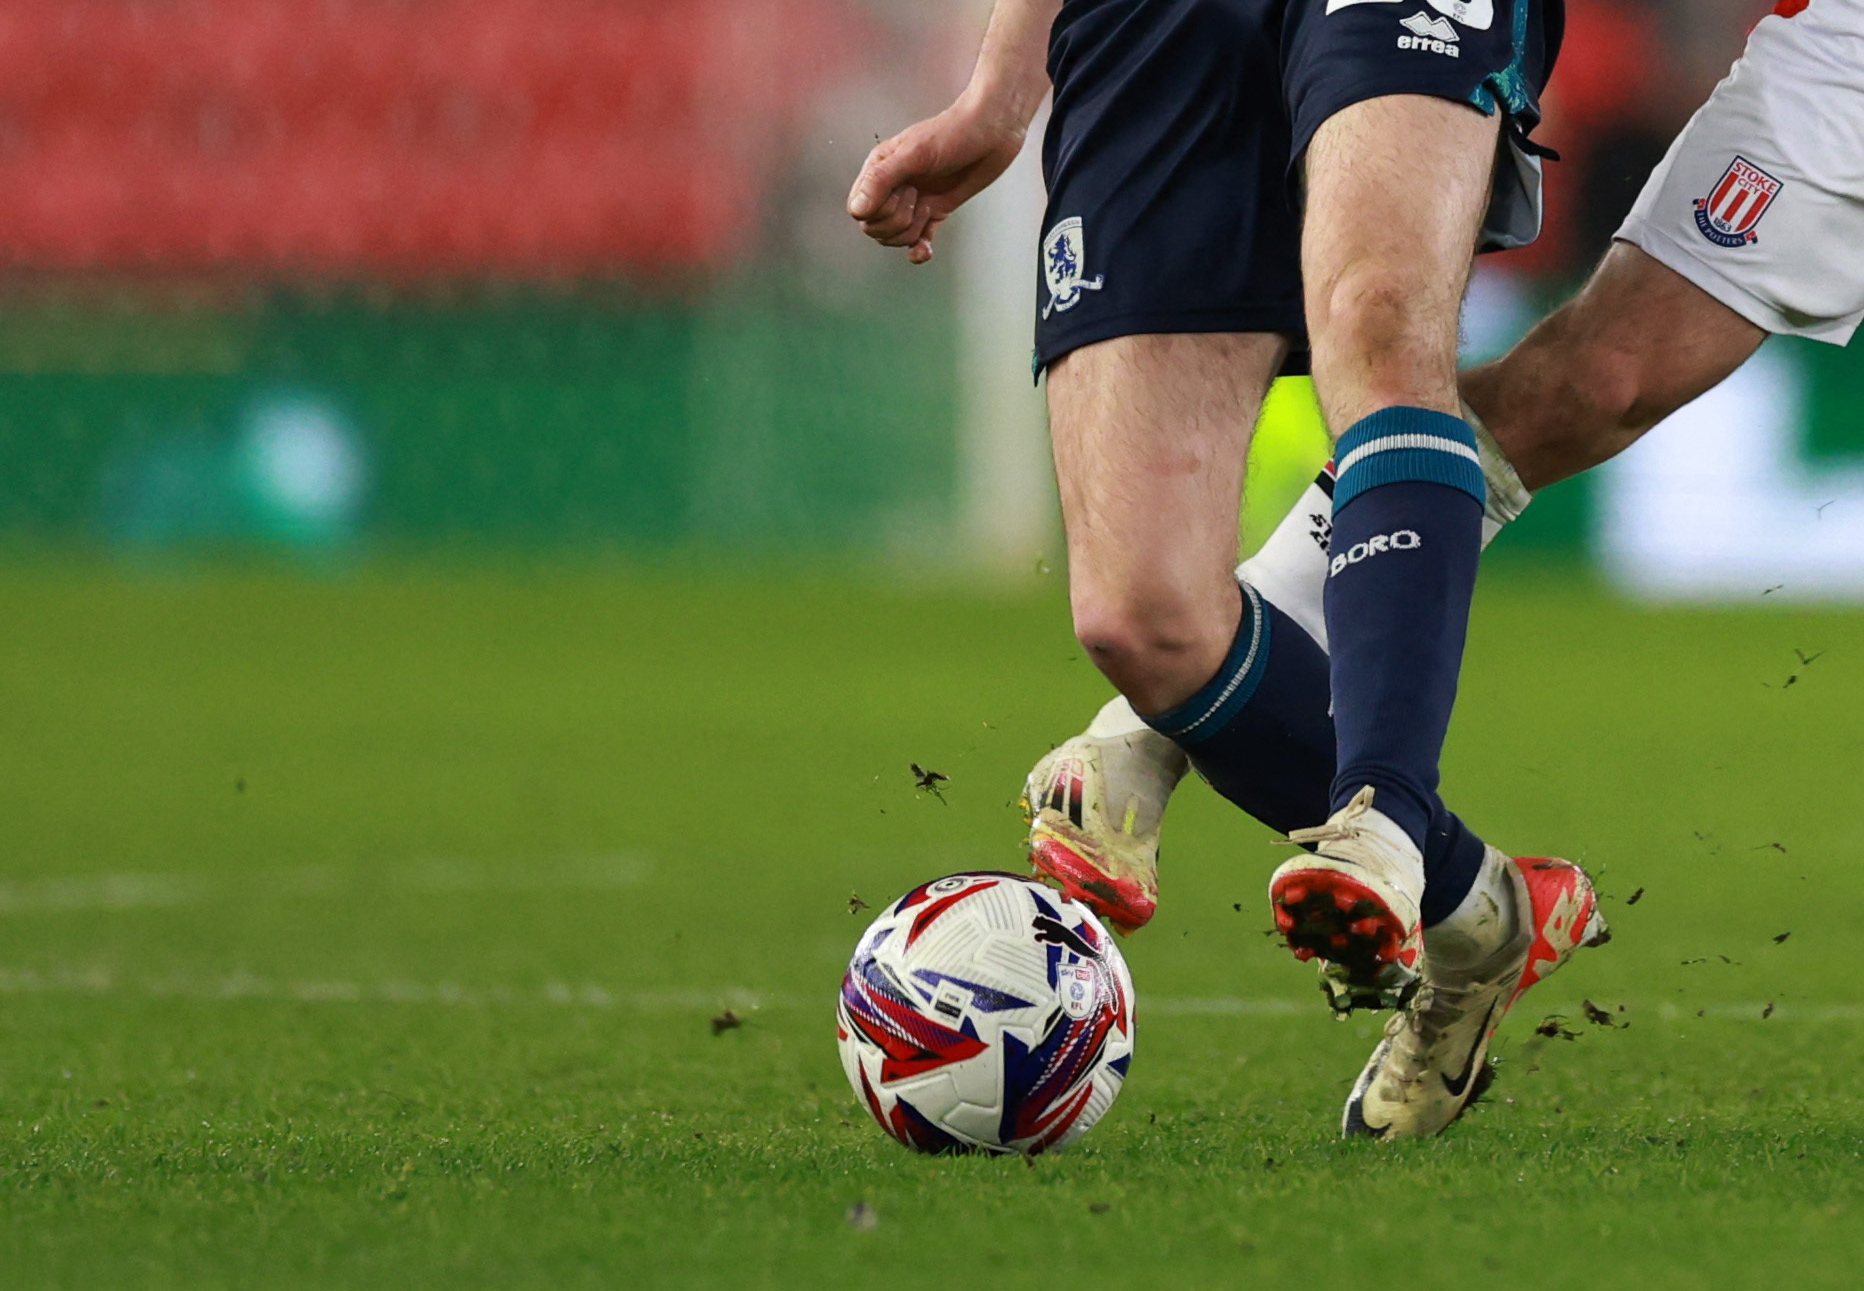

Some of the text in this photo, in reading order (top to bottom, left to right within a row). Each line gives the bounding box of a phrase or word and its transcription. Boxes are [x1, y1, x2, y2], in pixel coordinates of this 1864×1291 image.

[1397, 35, 1460, 58] errea
[1733, 162, 1777, 195] STOKE
[1738, 178, 1760, 195] CITY
[1713, 217, 1732, 232] 1863
[1330, 530, 1421, 578] BORO
